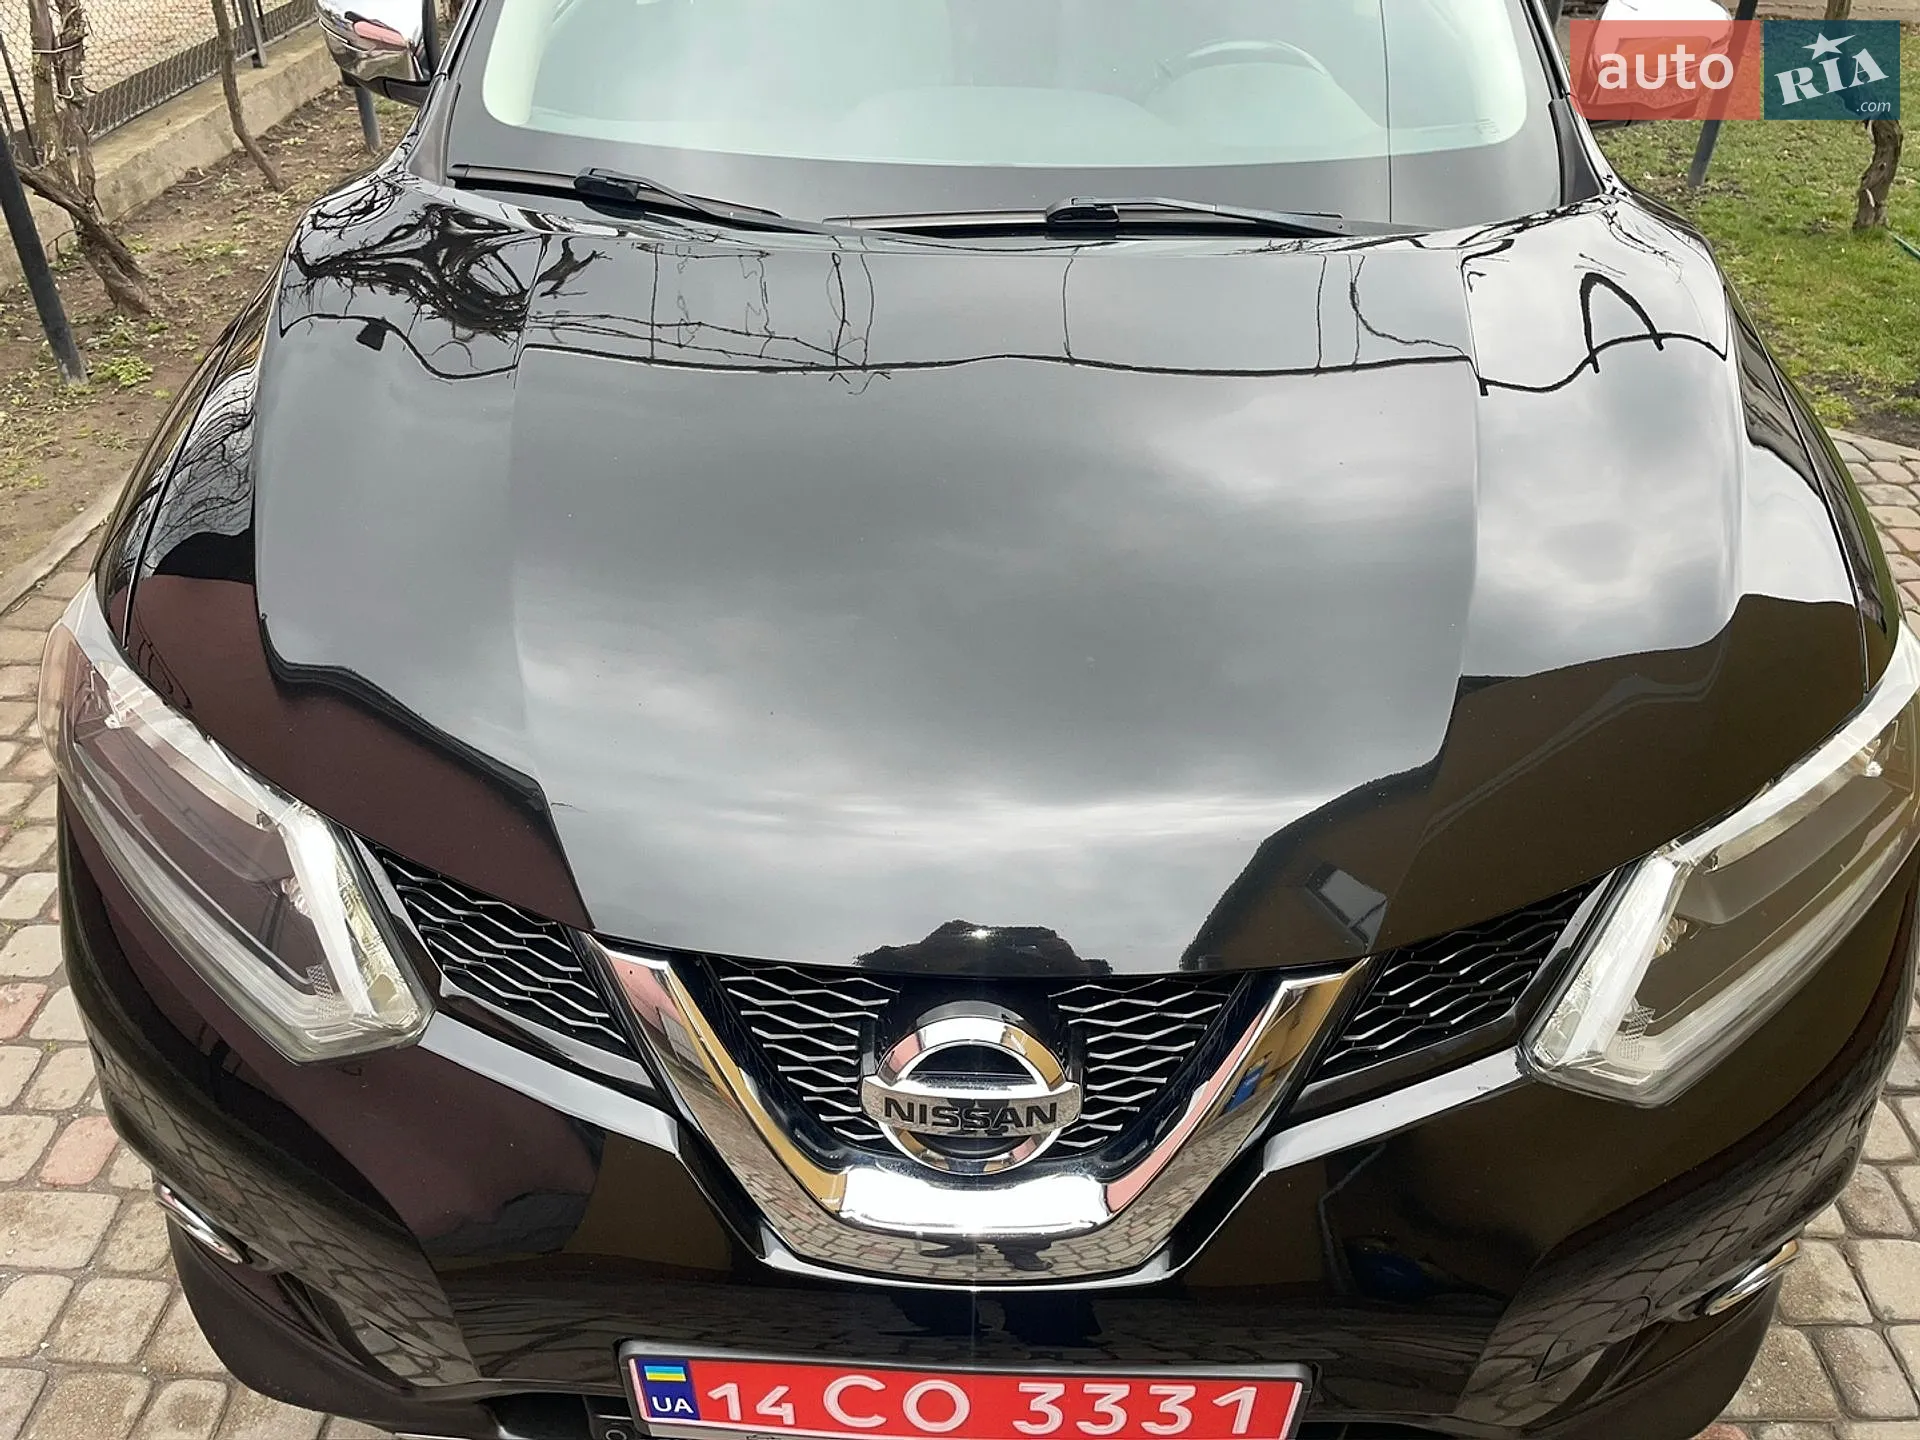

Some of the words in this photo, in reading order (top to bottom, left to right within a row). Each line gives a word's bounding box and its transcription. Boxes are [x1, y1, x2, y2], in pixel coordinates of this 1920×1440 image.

[883, 1097, 1058, 1130] NISSAN
[652, 1396, 694, 1413] UA
[707, 1382, 795, 1425] 14
[822, 1374, 971, 1433] CO
[1012, 1382, 1258, 1435] 3331
